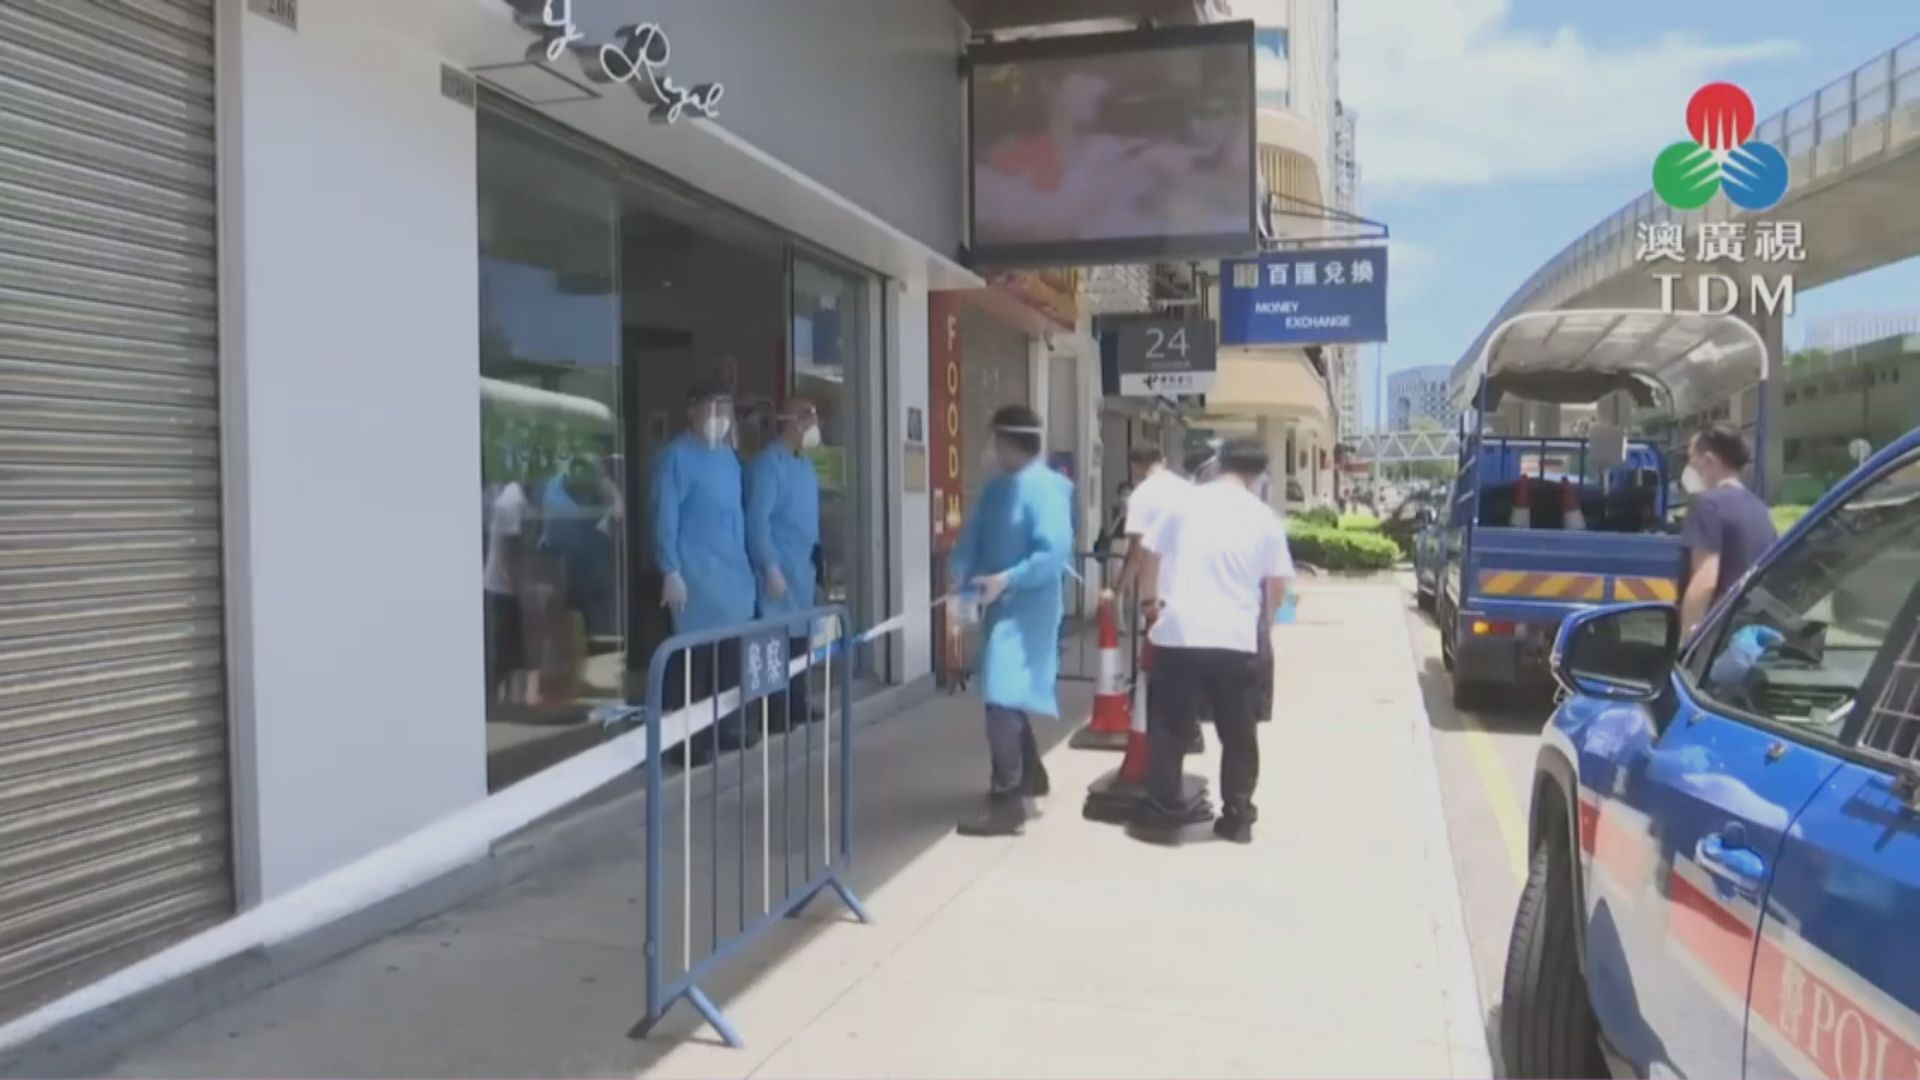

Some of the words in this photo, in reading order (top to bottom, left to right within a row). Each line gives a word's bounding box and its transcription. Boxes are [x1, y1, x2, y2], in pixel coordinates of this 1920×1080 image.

[1255, 302, 1300, 314] MONEY
[1285, 316, 1351, 329] EXCHANGE
[1144, 328, 1190, 360] 24
[947, 315, 960, 480] FOOD
